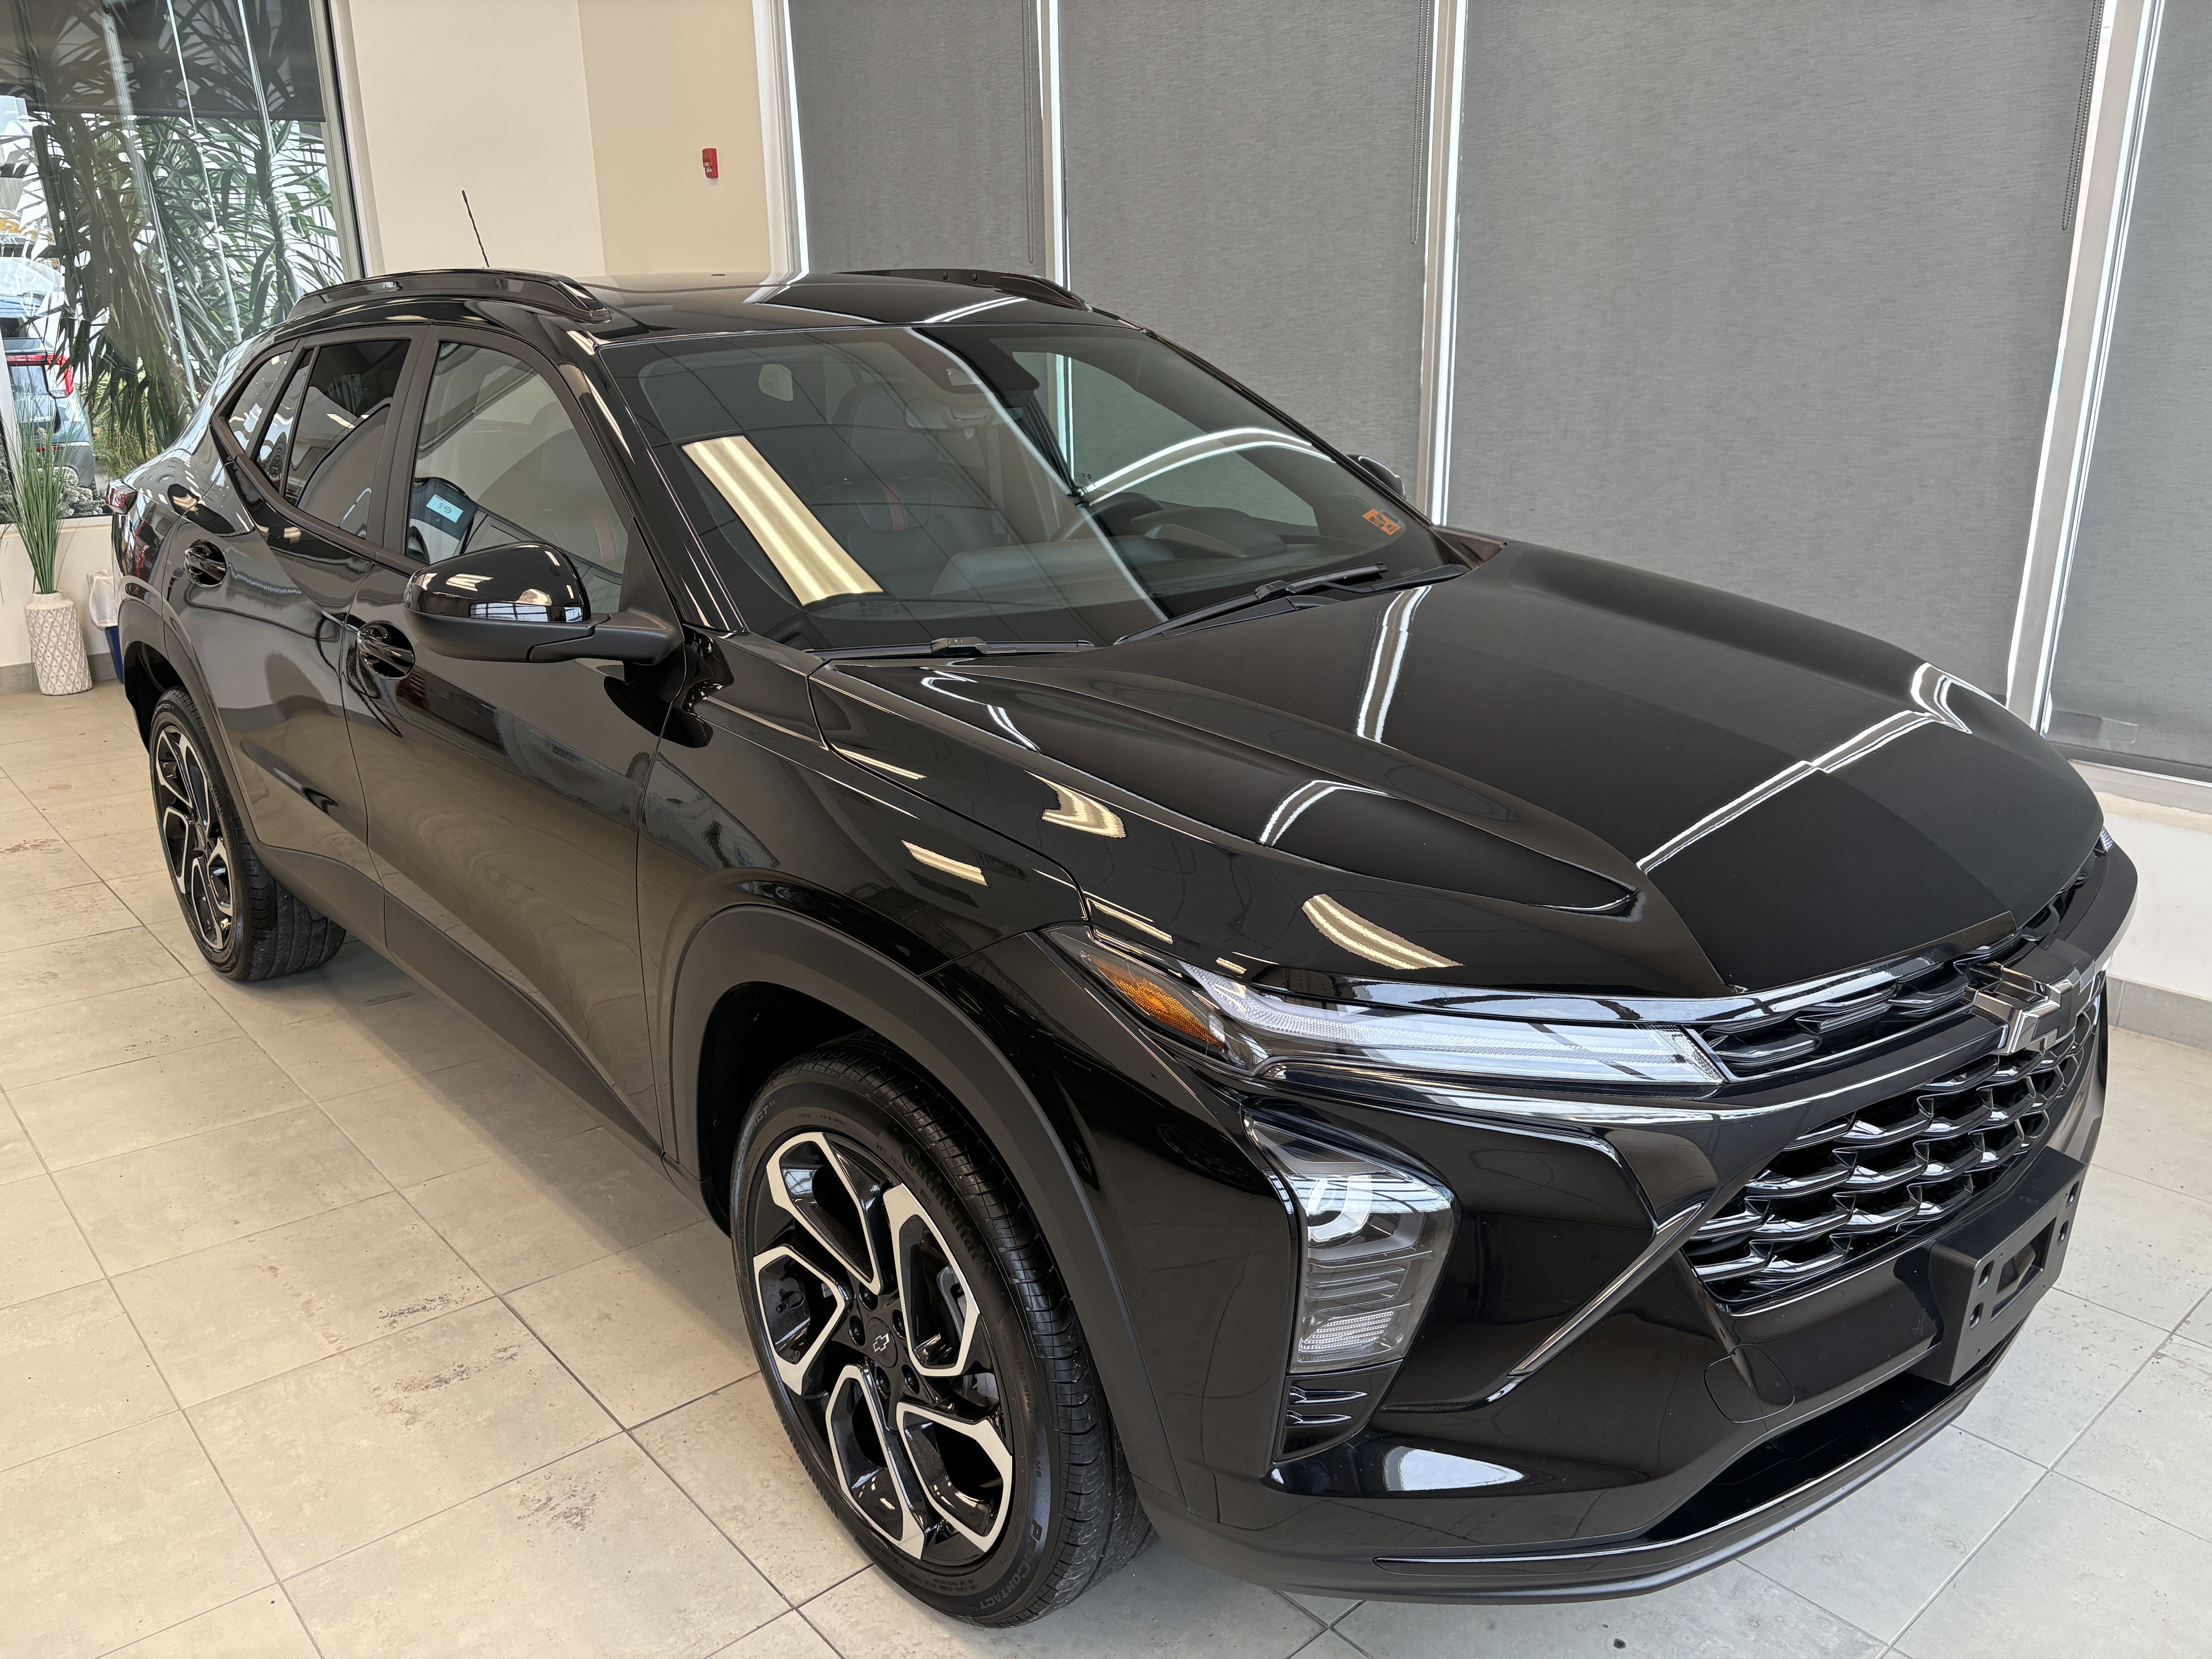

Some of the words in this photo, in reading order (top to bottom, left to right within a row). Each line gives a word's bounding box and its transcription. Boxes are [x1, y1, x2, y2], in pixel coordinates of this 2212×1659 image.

[876, 1142, 887, 1154] DOT
[902, 1144, 985, 1262] Continental
[979, 1518, 1043, 1611] PROCONTACT
